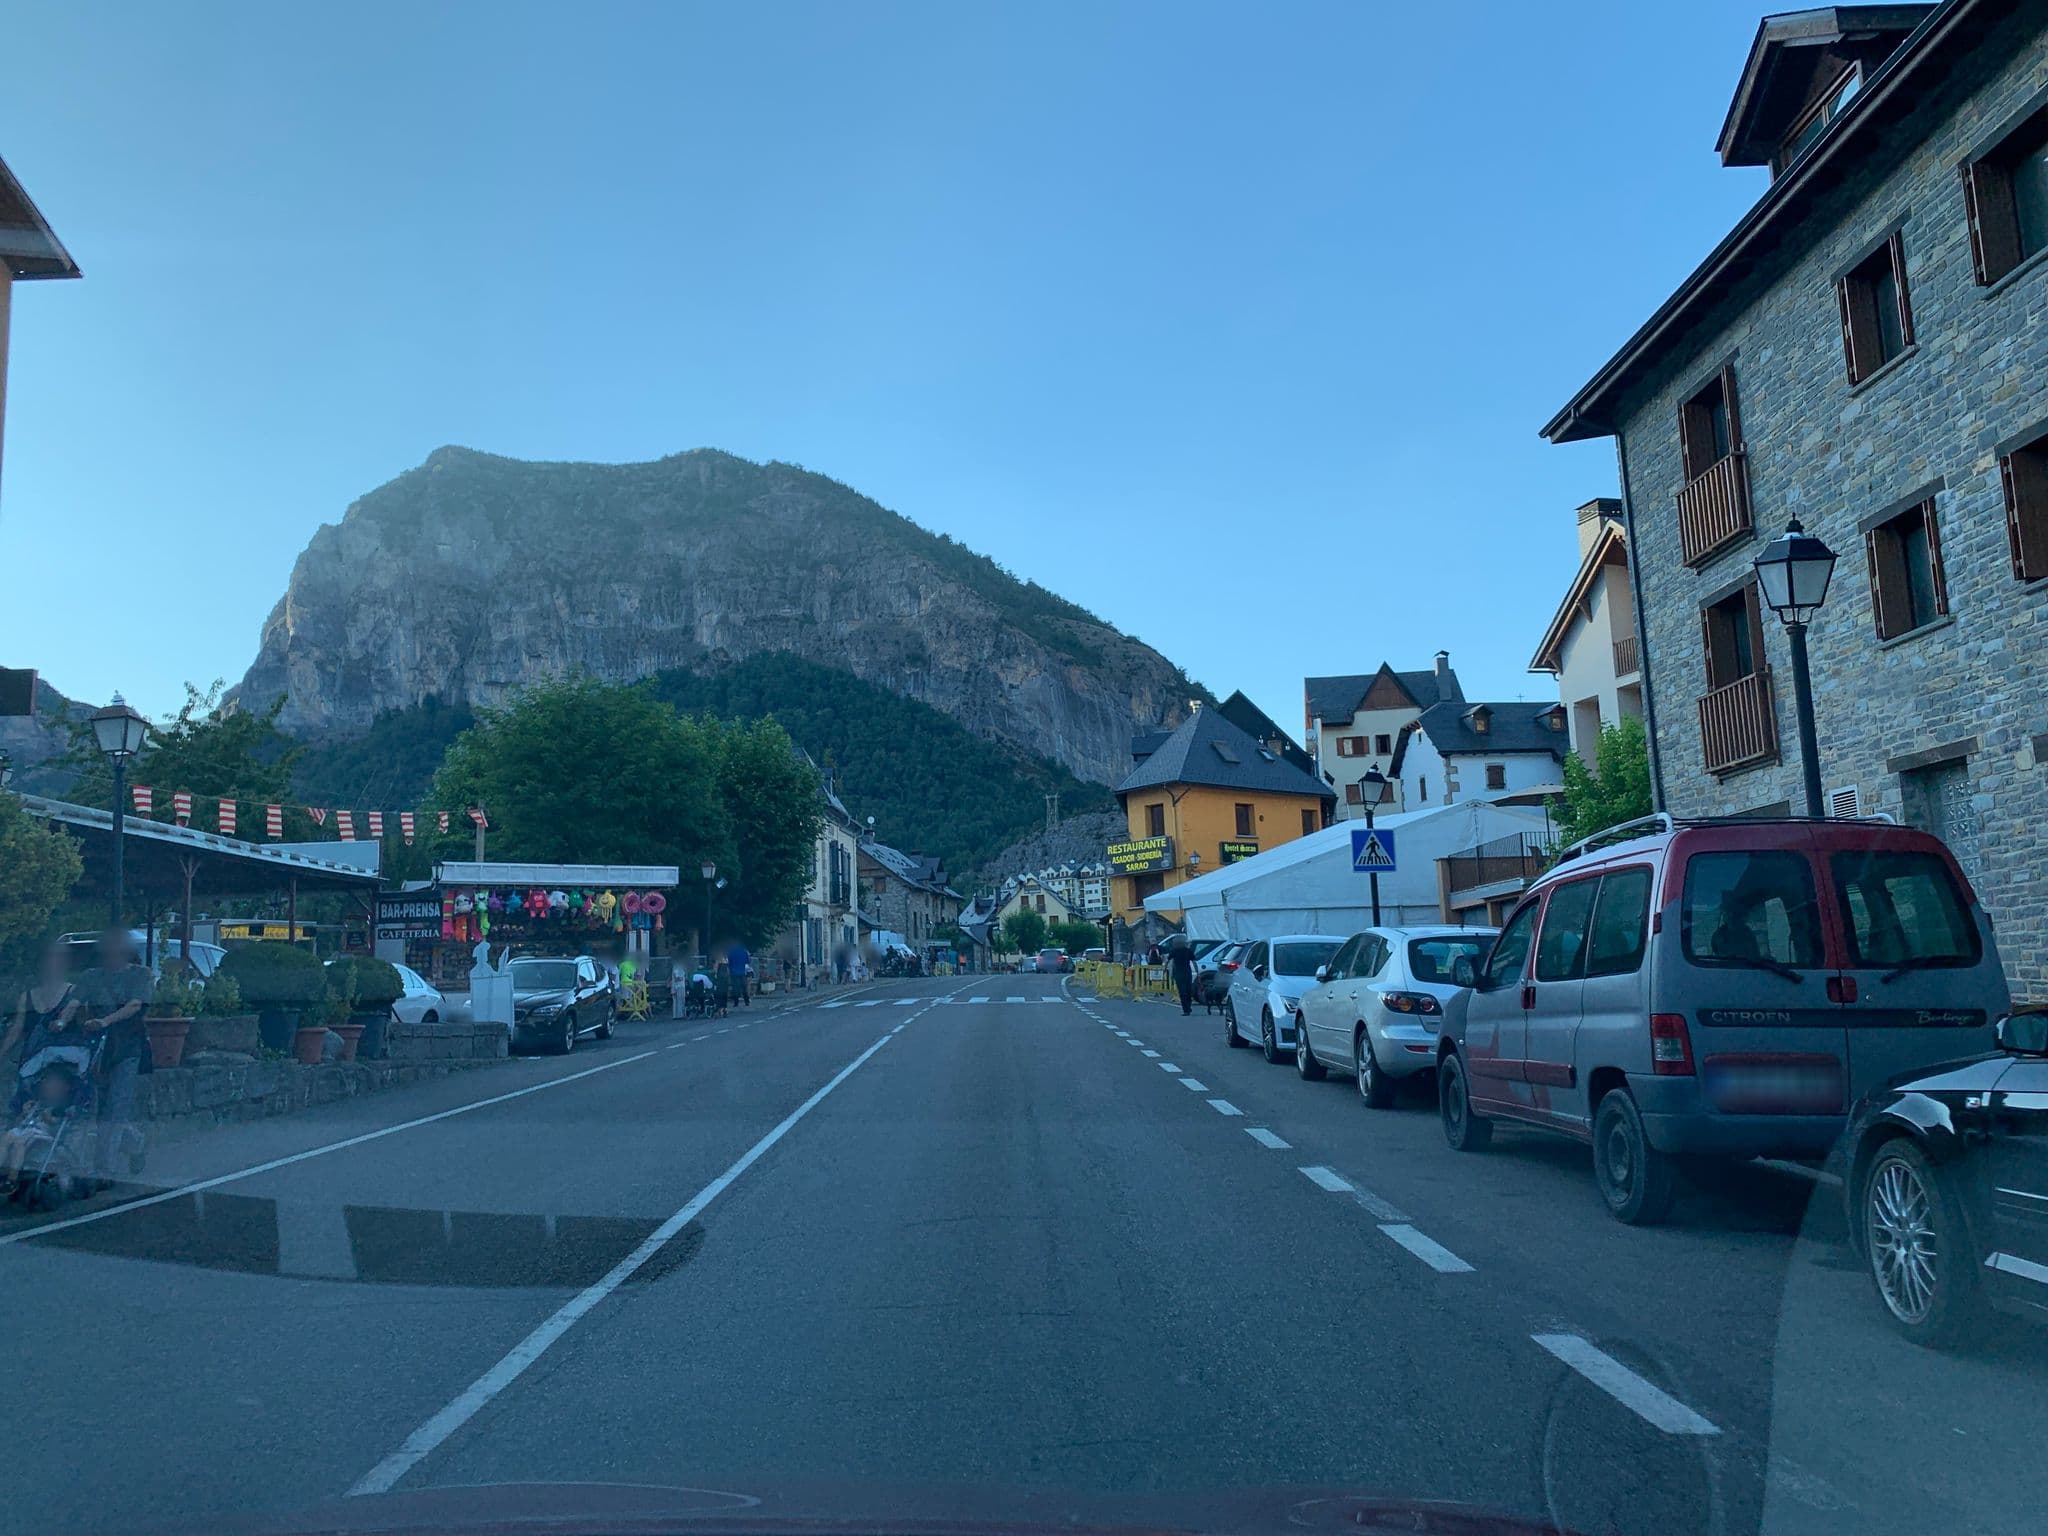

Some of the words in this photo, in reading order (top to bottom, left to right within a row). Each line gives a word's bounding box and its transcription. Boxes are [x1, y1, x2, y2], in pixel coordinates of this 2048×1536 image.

[1107, 838, 1168, 855] RESTAURANTE
[1126, 861, 1149, 871] SARAO
[380, 929, 440, 938] CAFETERIA
